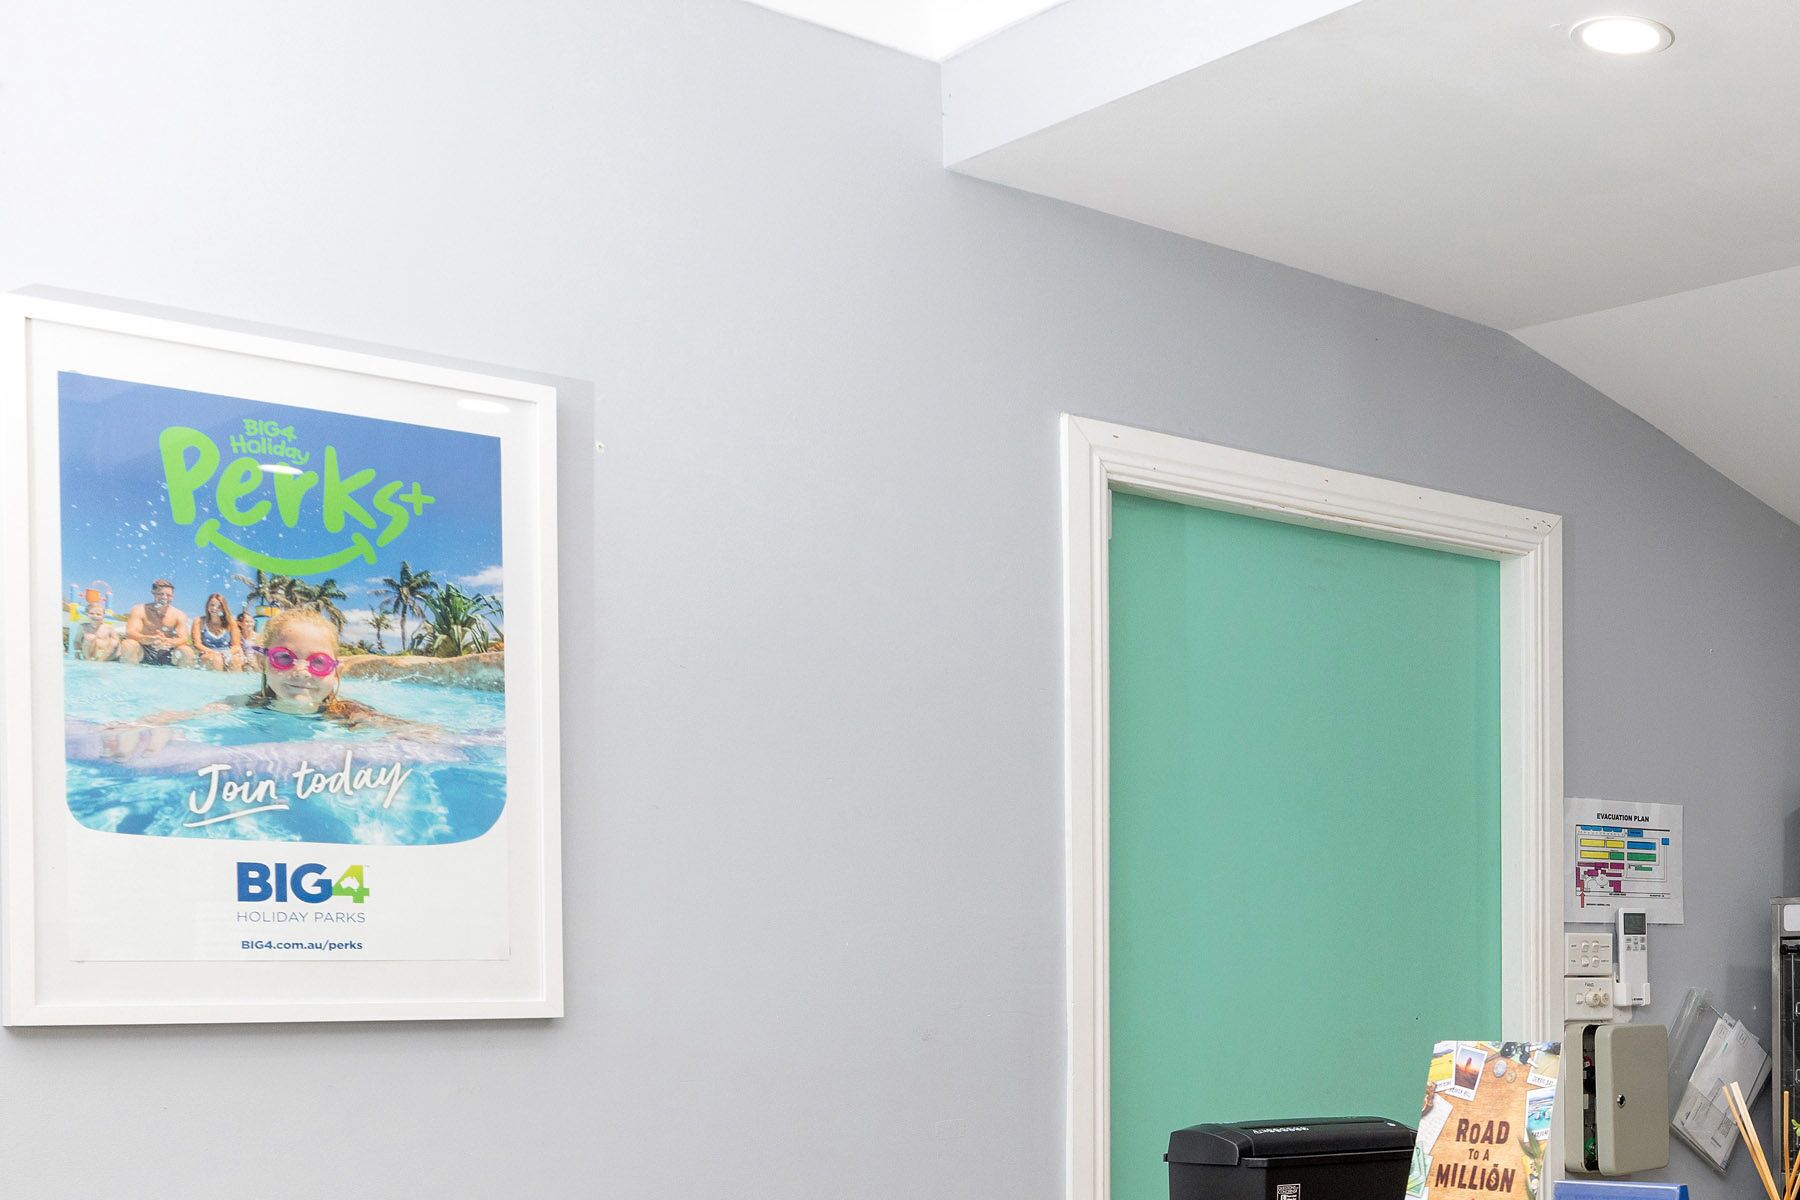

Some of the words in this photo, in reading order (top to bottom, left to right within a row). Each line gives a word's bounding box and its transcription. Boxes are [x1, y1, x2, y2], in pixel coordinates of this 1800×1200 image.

[243, 419, 296, 442] BIG4
[230, 434, 310, 465] Holiday
[189, 764, 278, 814] Join
[293, 750, 413, 808] today
[1597, 813, 1633, 822] EVACUATION
[237, 862, 369, 903] BIG4
[237, 911, 309, 923] HOLIDAY
[315, 912, 365, 924] PARKS
[241, 940, 363, 951] BIG4.com.au/perks
[1482, 1149, 1490, 1161] A
[1435, 1163, 1516, 1193] MILLION
